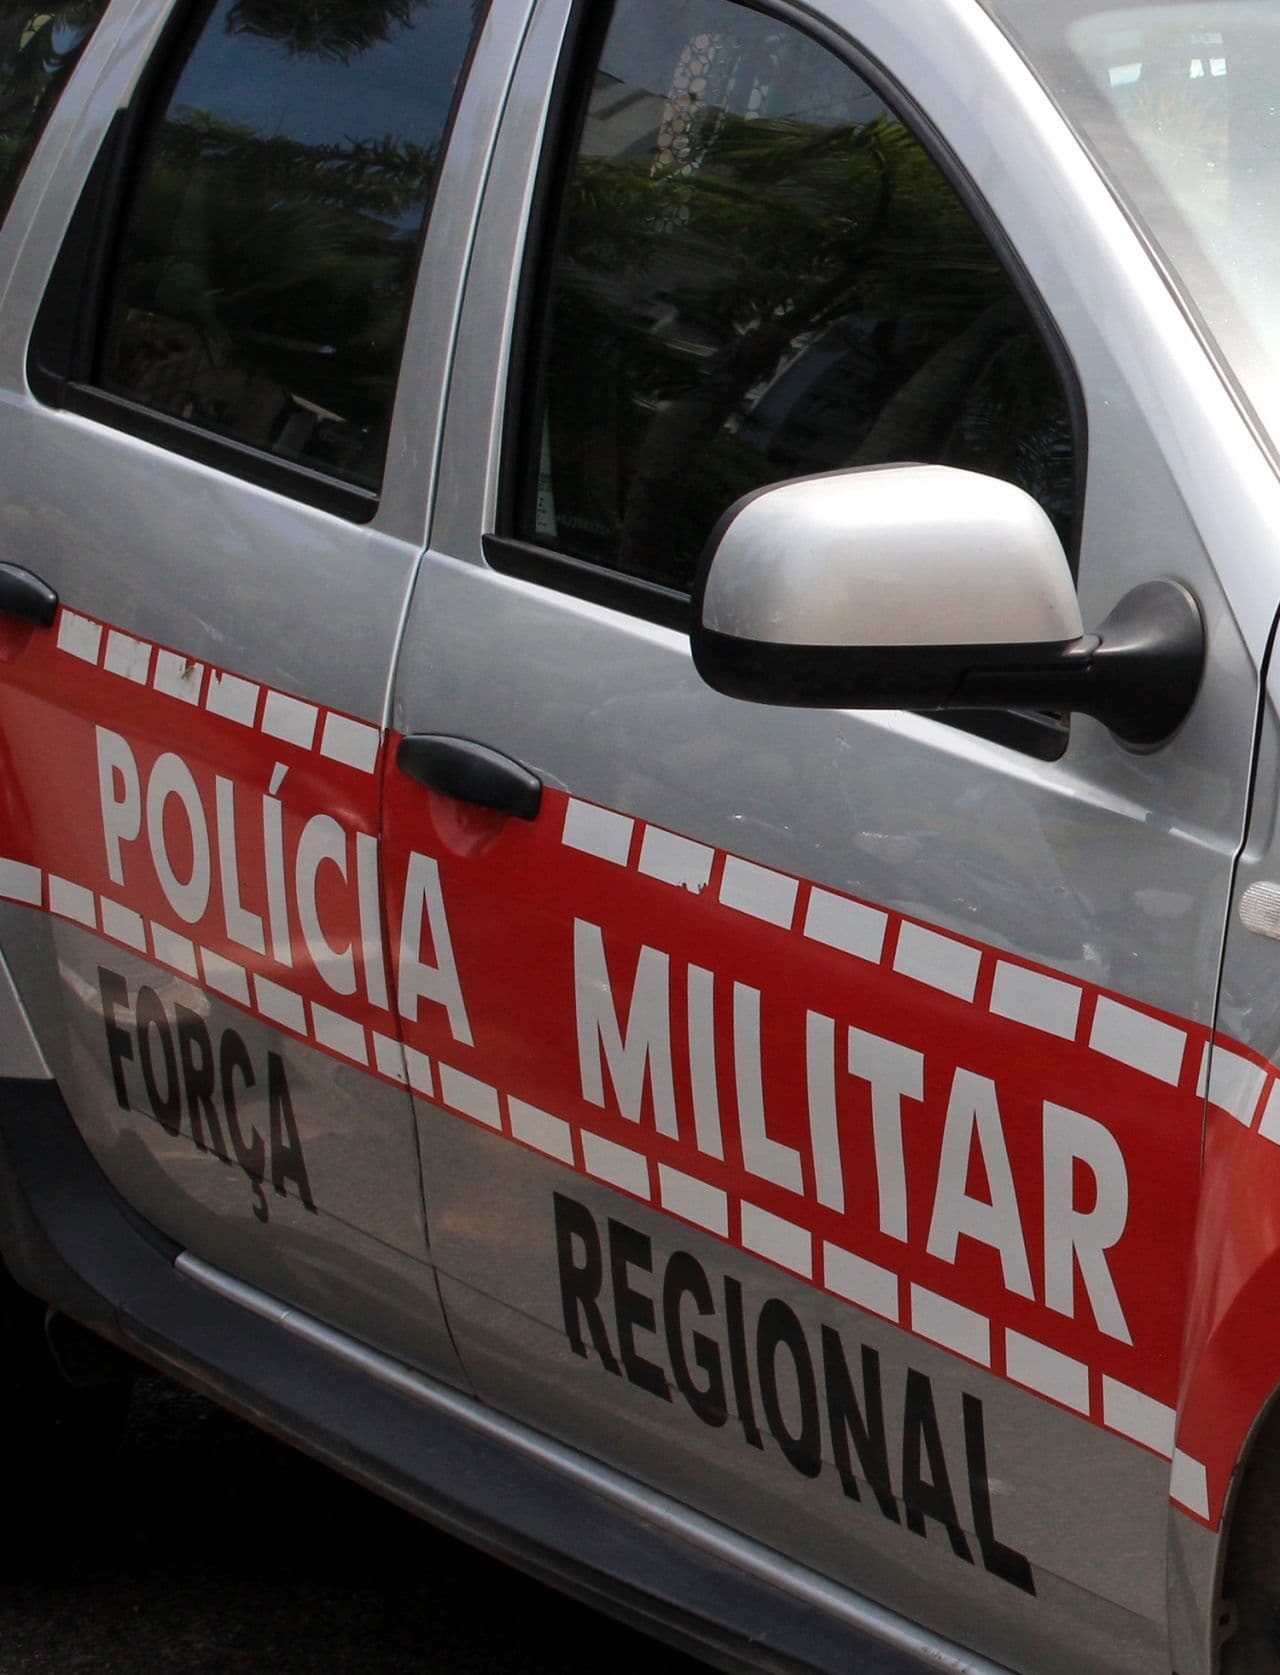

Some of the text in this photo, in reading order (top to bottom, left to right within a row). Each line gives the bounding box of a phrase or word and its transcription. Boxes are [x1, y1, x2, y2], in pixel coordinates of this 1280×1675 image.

[94, 724, 1134, 1347] POLÍCIA MILITAR
[97, 966, 1037, 1598] FORÇA REGIONAL
